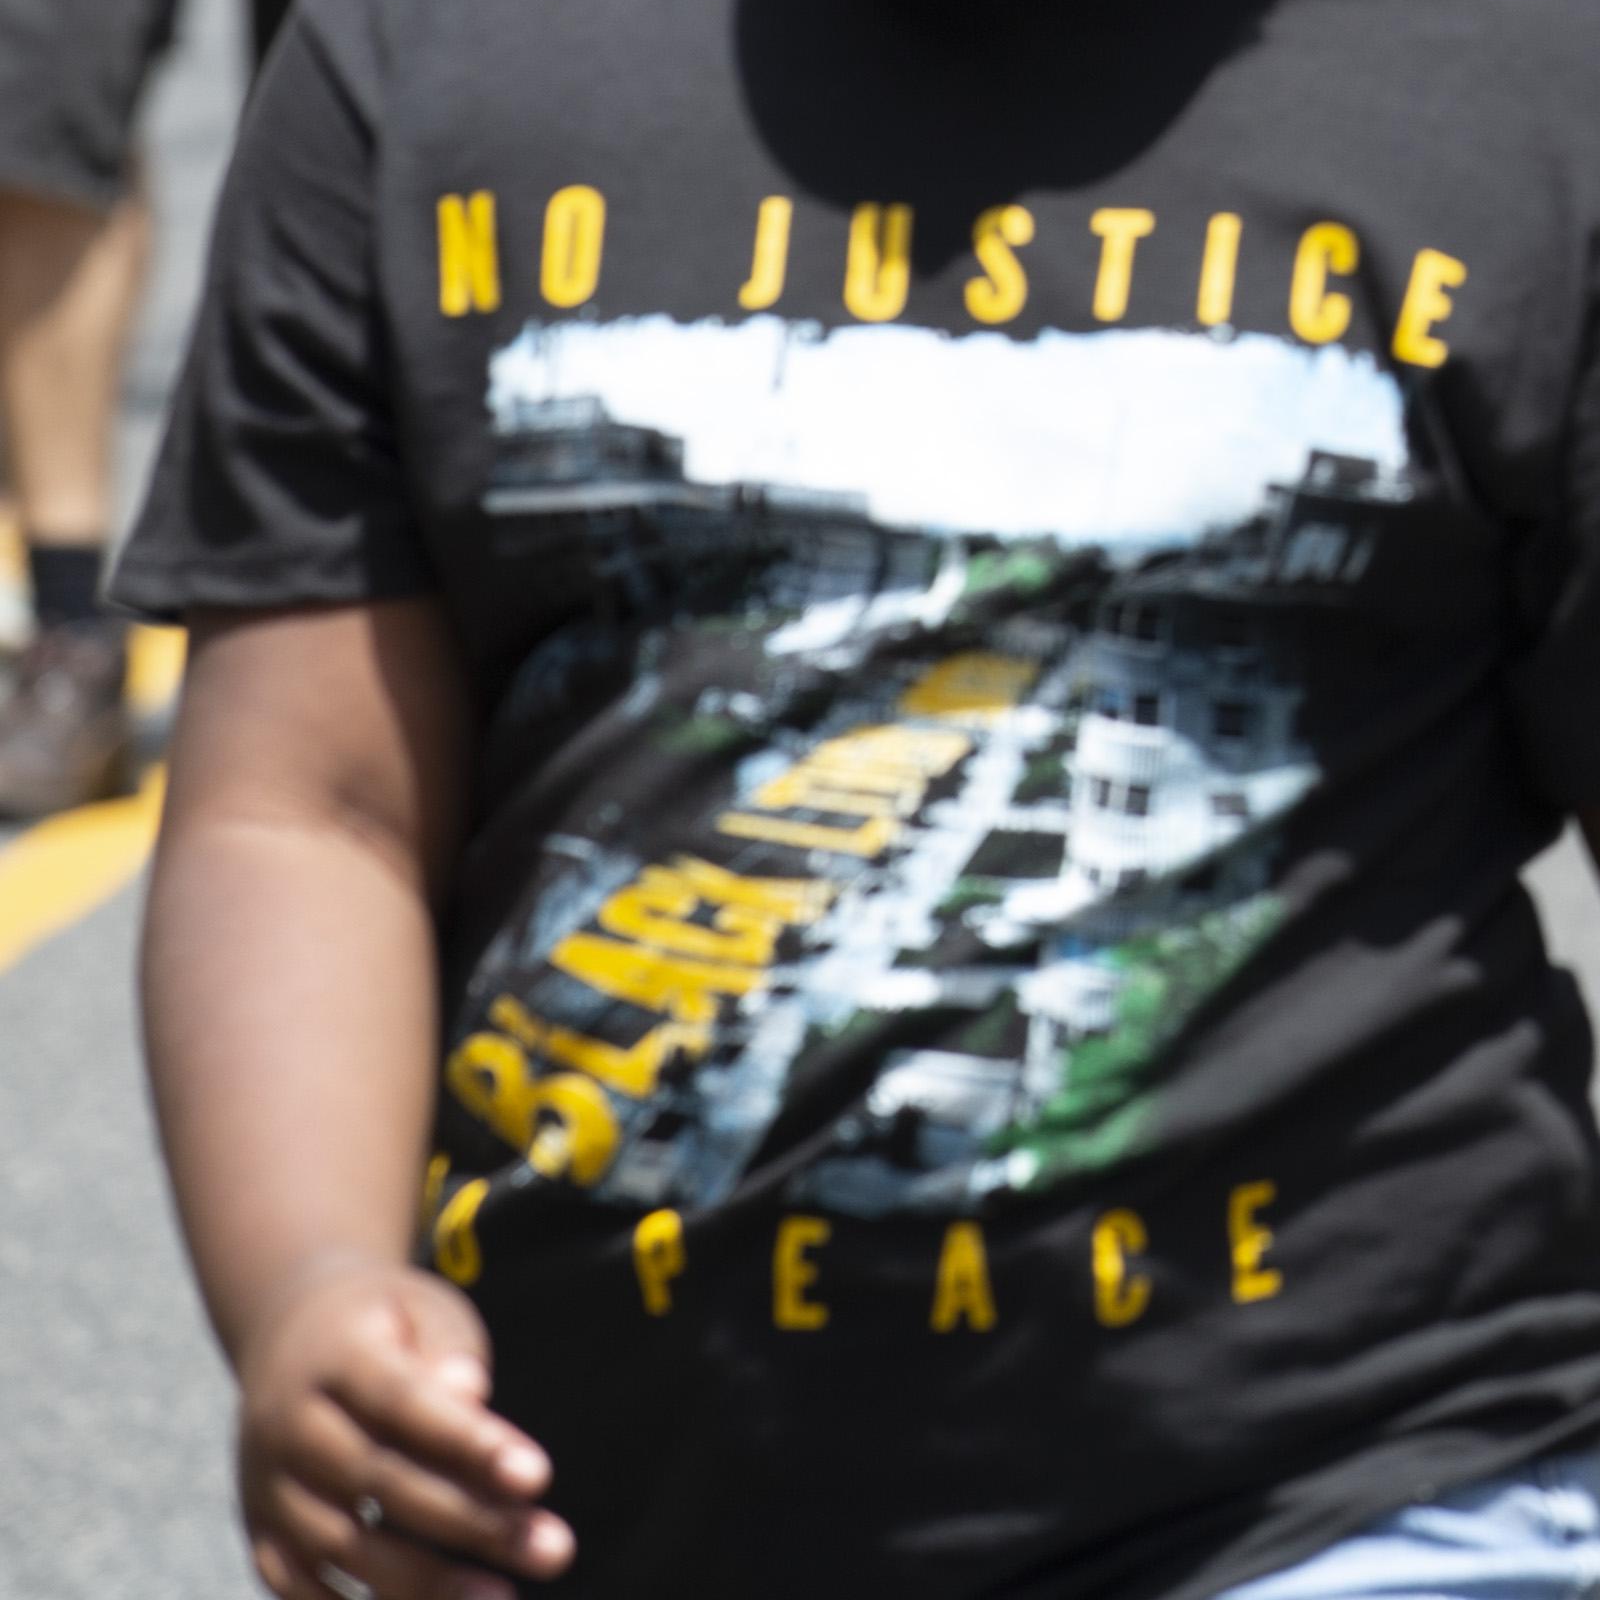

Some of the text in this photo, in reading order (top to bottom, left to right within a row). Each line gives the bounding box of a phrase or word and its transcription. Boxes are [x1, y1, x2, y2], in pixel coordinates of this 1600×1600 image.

[437, 185, 1468, 368] NO JUSTICE
[633, 1182, 1284, 1333] PEACE
